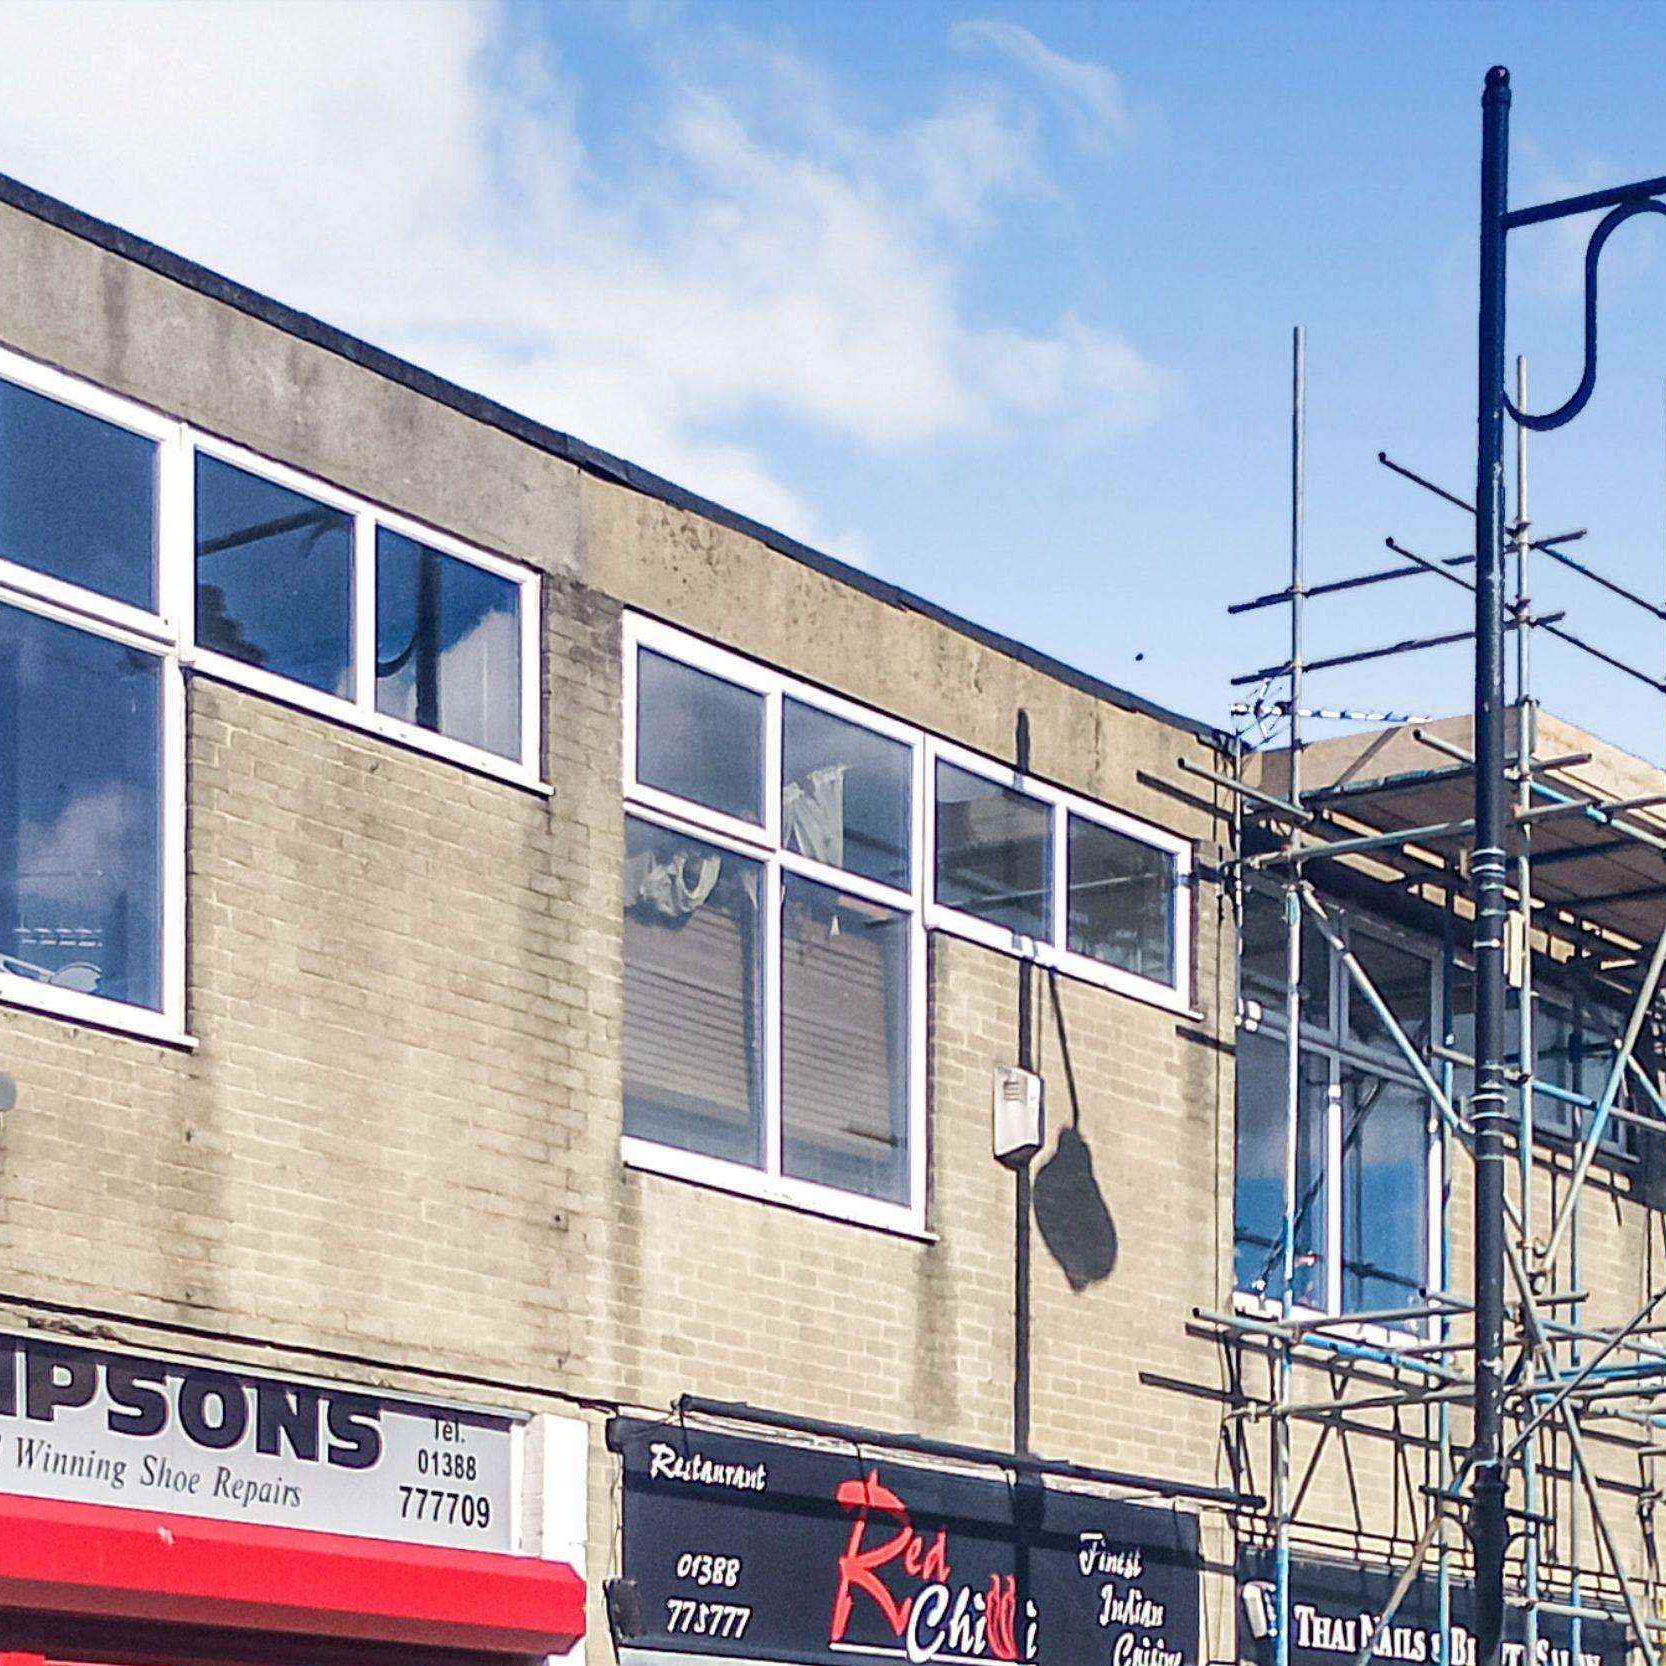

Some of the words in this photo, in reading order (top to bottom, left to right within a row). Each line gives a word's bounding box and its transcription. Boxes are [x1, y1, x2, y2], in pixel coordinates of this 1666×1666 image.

[14, 1436, 126, 1487] Winning
[140, 1453, 201, 1491] Shoe
[212, 1466, 303, 1510] Repairs
[417, 1448, 478, 1482] 01388
[398, 1484, 492, 1531] 777709
[676, 1553, 742, 1588] 01388
[829, 1467, 951, 1643] Red
[1079, 1532, 1144, 1580] Finest
[666, 1598, 752, 1639] 775777
[906, 1573, 1037, 1664] Chilli
[1099, 1583, 1165, 1628] Indian
